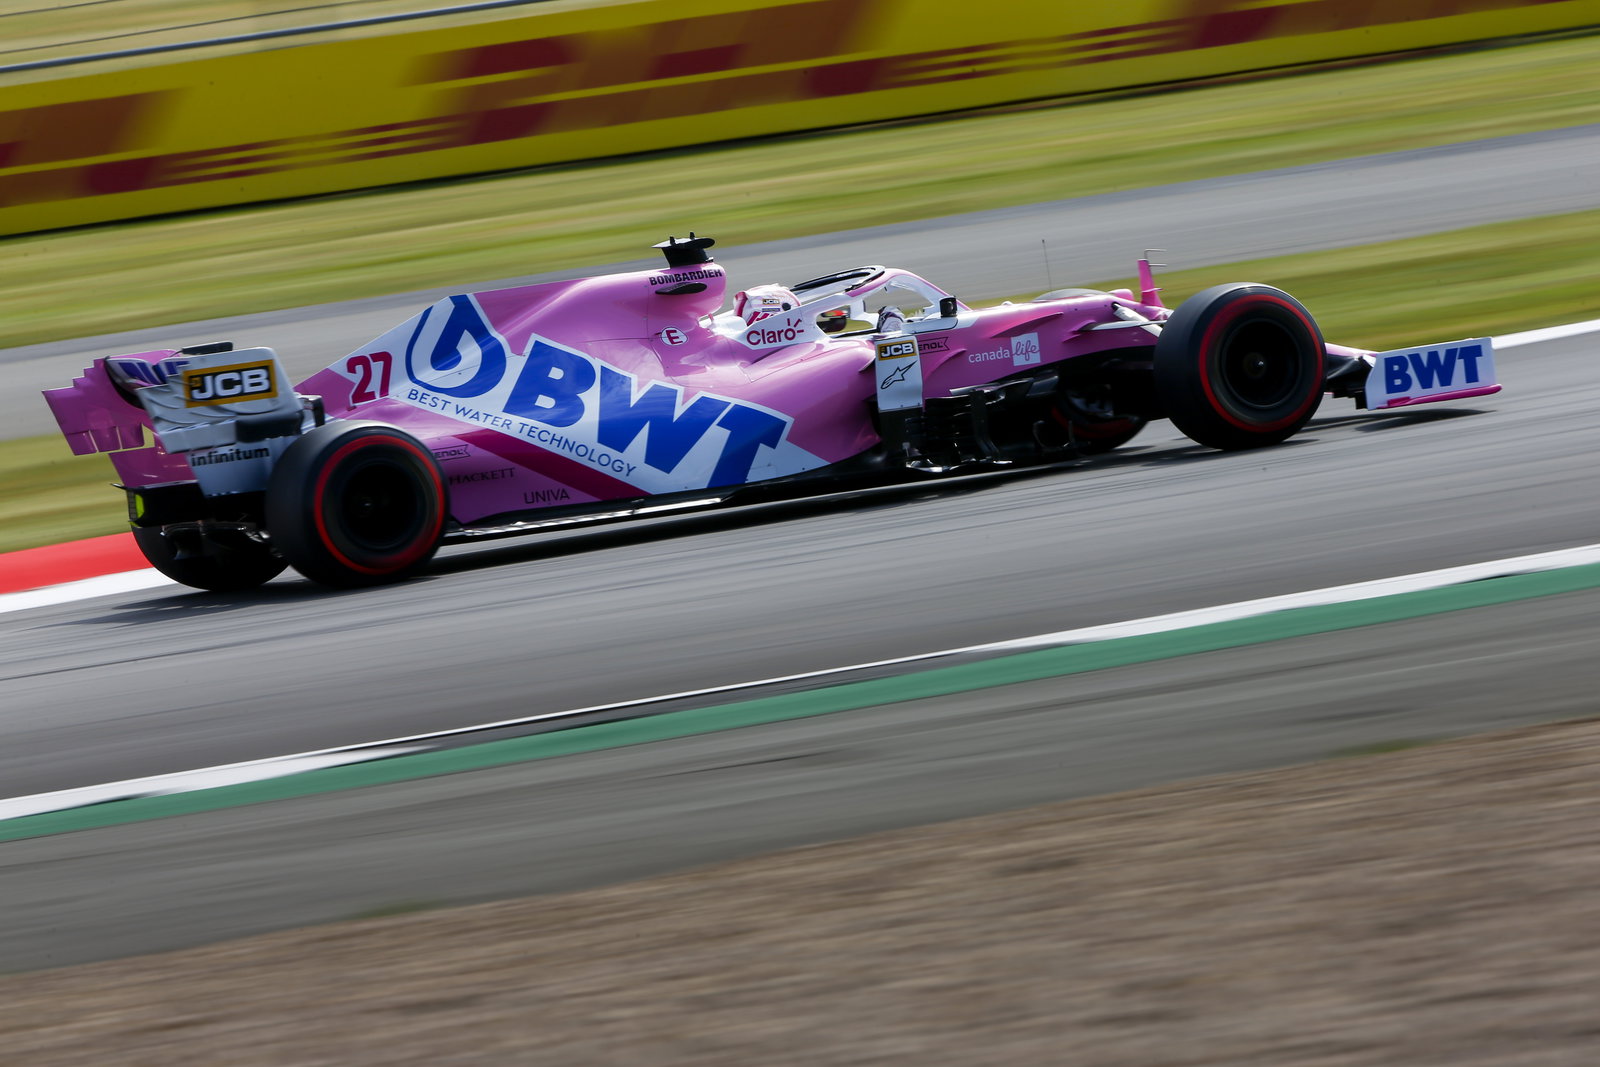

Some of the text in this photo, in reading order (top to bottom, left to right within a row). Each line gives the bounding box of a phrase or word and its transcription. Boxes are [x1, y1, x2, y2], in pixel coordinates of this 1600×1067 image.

[649, 269, 722, 286] BOMBARDIER
[746, 326, 796, 346] Claro
[881, 343, 914, 357] JCB
[968, 339, 1040, 363] canada life
[346, 351, 393, 404] 27
[1384, 345, 1483, 394] BWT
[191, 368, 271, 400] JCB
[502, 340, 787, 488] BWT
[407, 388, 638, 477] BEST WATER TECHNOLOGY
[191, 447, 270, 467] infinitum
[449, 467, 516, 485] HACKETT
[523, 488, 571, 505] UNIVA
